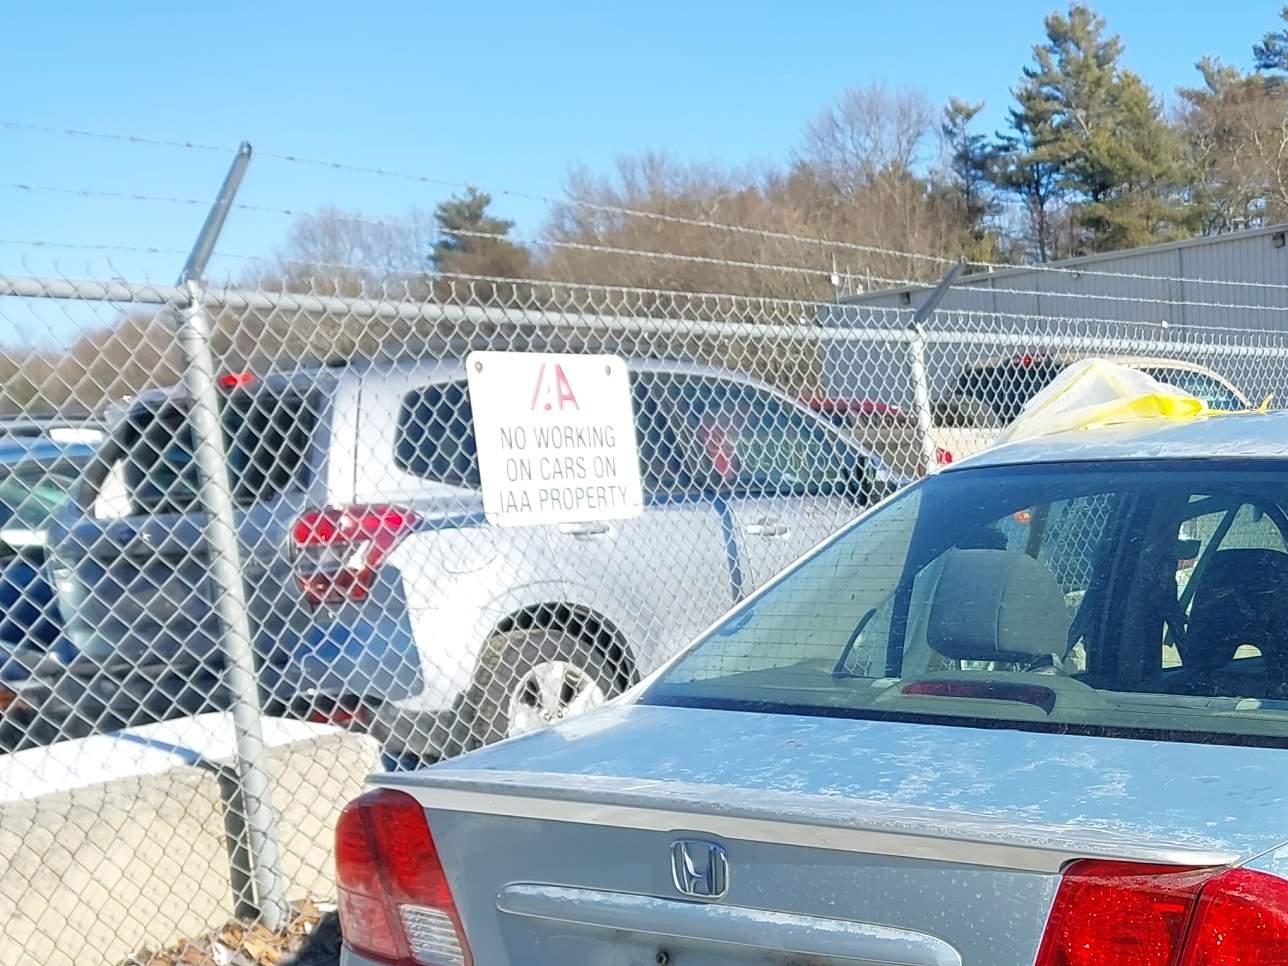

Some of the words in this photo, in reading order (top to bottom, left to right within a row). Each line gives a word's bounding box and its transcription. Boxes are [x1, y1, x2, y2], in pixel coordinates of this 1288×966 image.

[500, 426, 527, 450] NO
[533, 425, 616, 449] WORKING
[506, 458, 532, 482] ON
[540, 456, 587, 480] CARS
[593, 455, 616, 479] ON
[499, 490, 532, 513] IAA
[539, 485, 628, 511] PROPERTY
